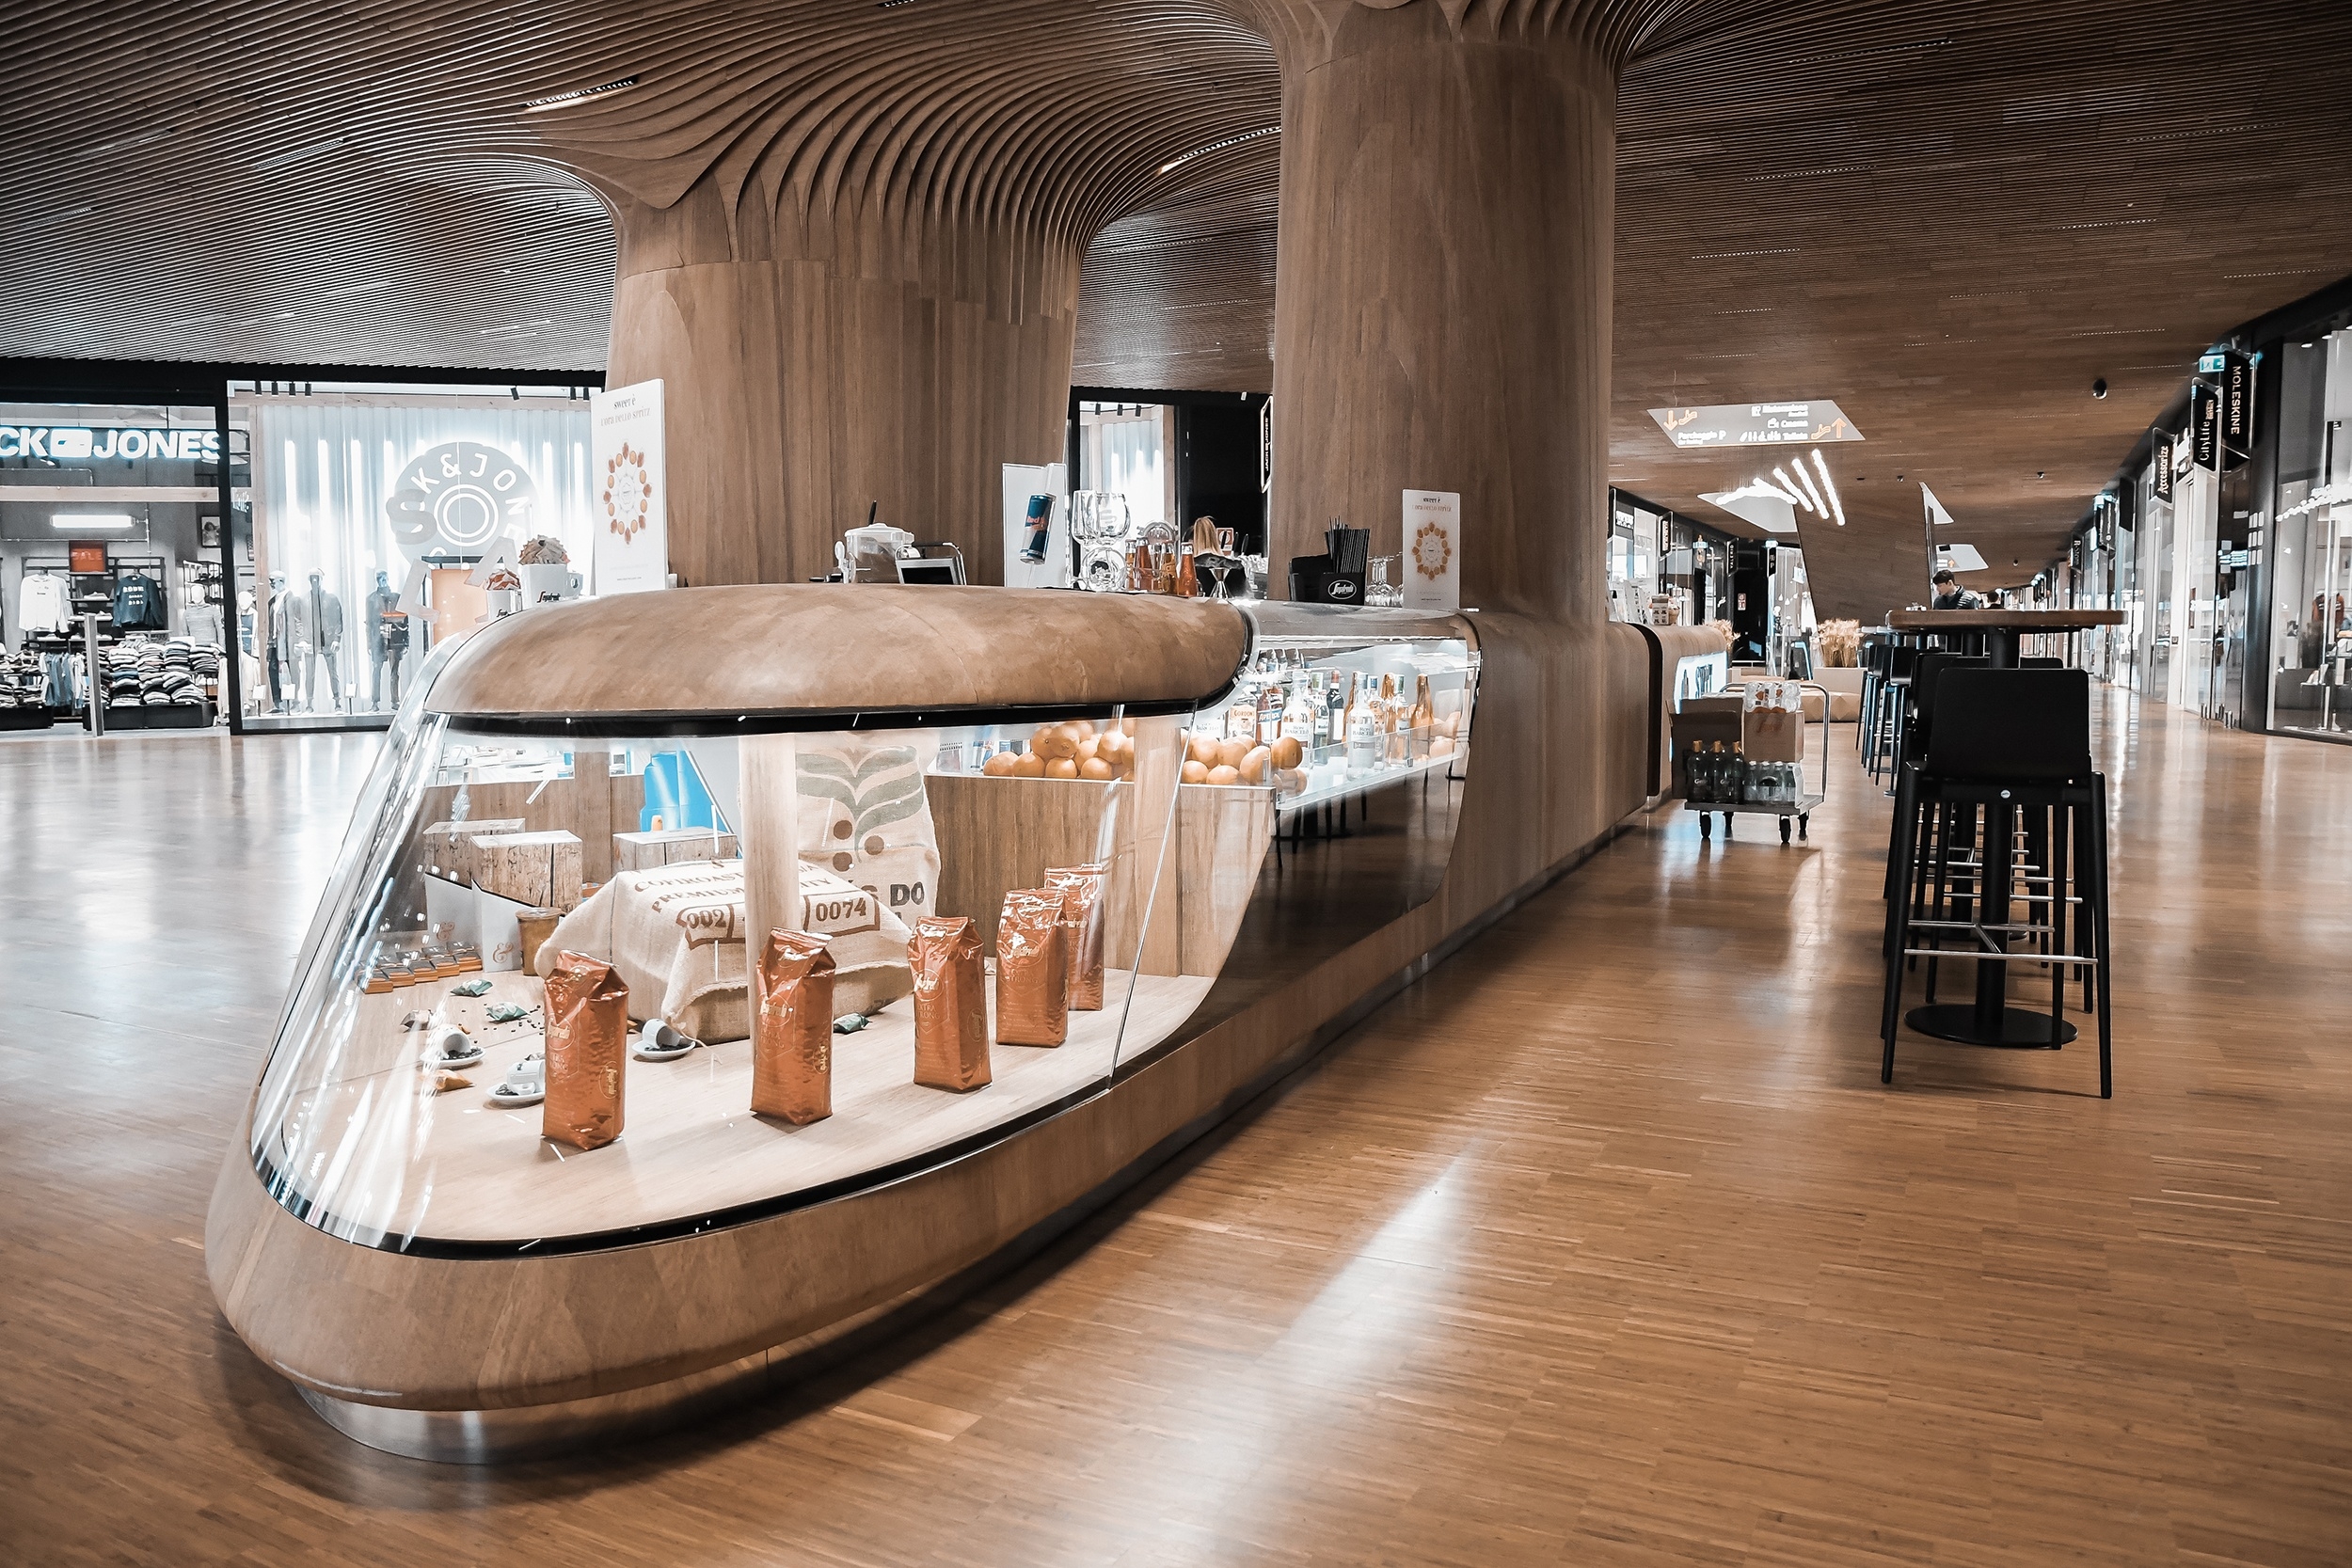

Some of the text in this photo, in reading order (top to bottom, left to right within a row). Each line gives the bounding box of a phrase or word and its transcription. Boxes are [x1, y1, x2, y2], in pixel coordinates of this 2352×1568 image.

[2230, 365, 2242, 435] MOLESKINE
[94, 429, 220, 460] JONES
[2198, 420, 2212, 461] CityLife
[2157, 446, 2169, 495] Accessorize
[71, 550, 103, 561] SALE
[687, 909, 727, 929] 002
[815, 897, 866, 922] 0074
